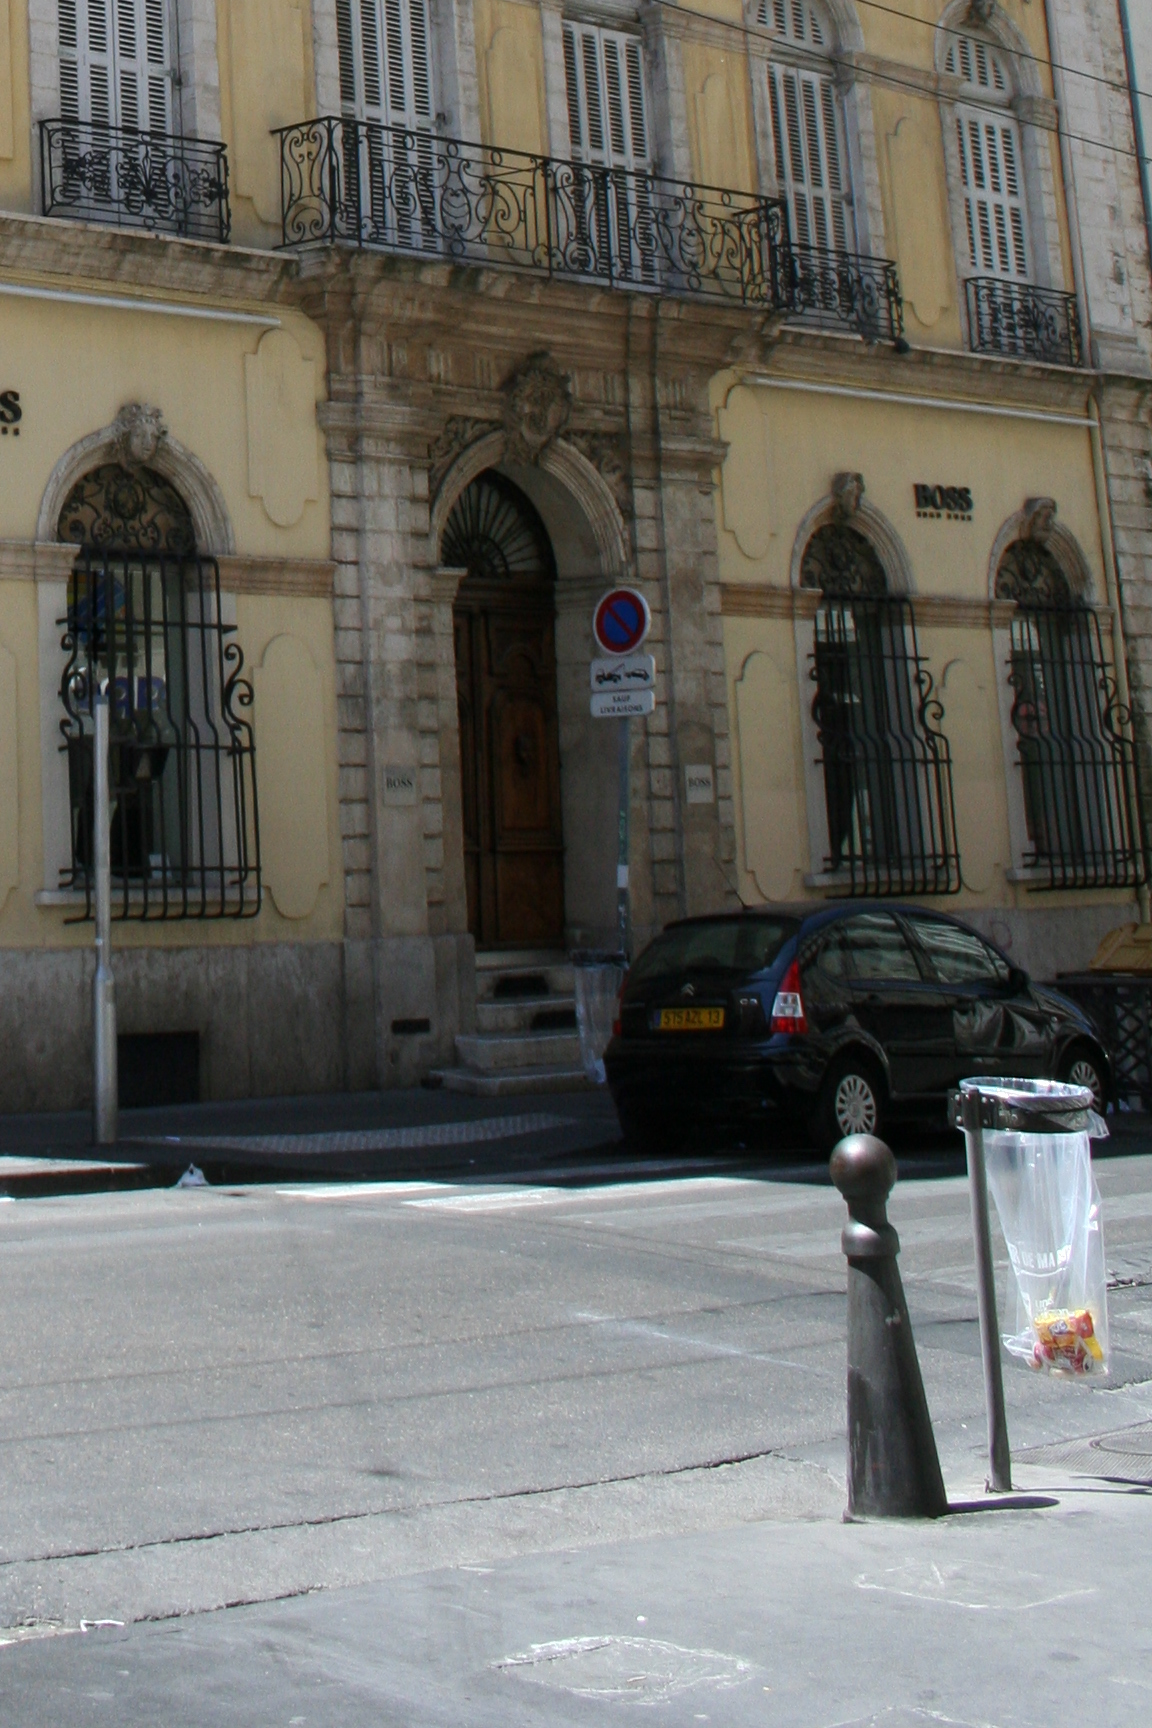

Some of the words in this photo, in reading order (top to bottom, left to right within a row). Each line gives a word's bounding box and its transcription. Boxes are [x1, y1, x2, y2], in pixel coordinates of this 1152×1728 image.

[913, 483, 973, 512] BOSS
[600, 705, 643, 714] LIVRAISONS
[386, 776, 413, 788] BOSS
[688, 777, 712, 788] BOSS
[708, 1009, 720, 1022] 13
